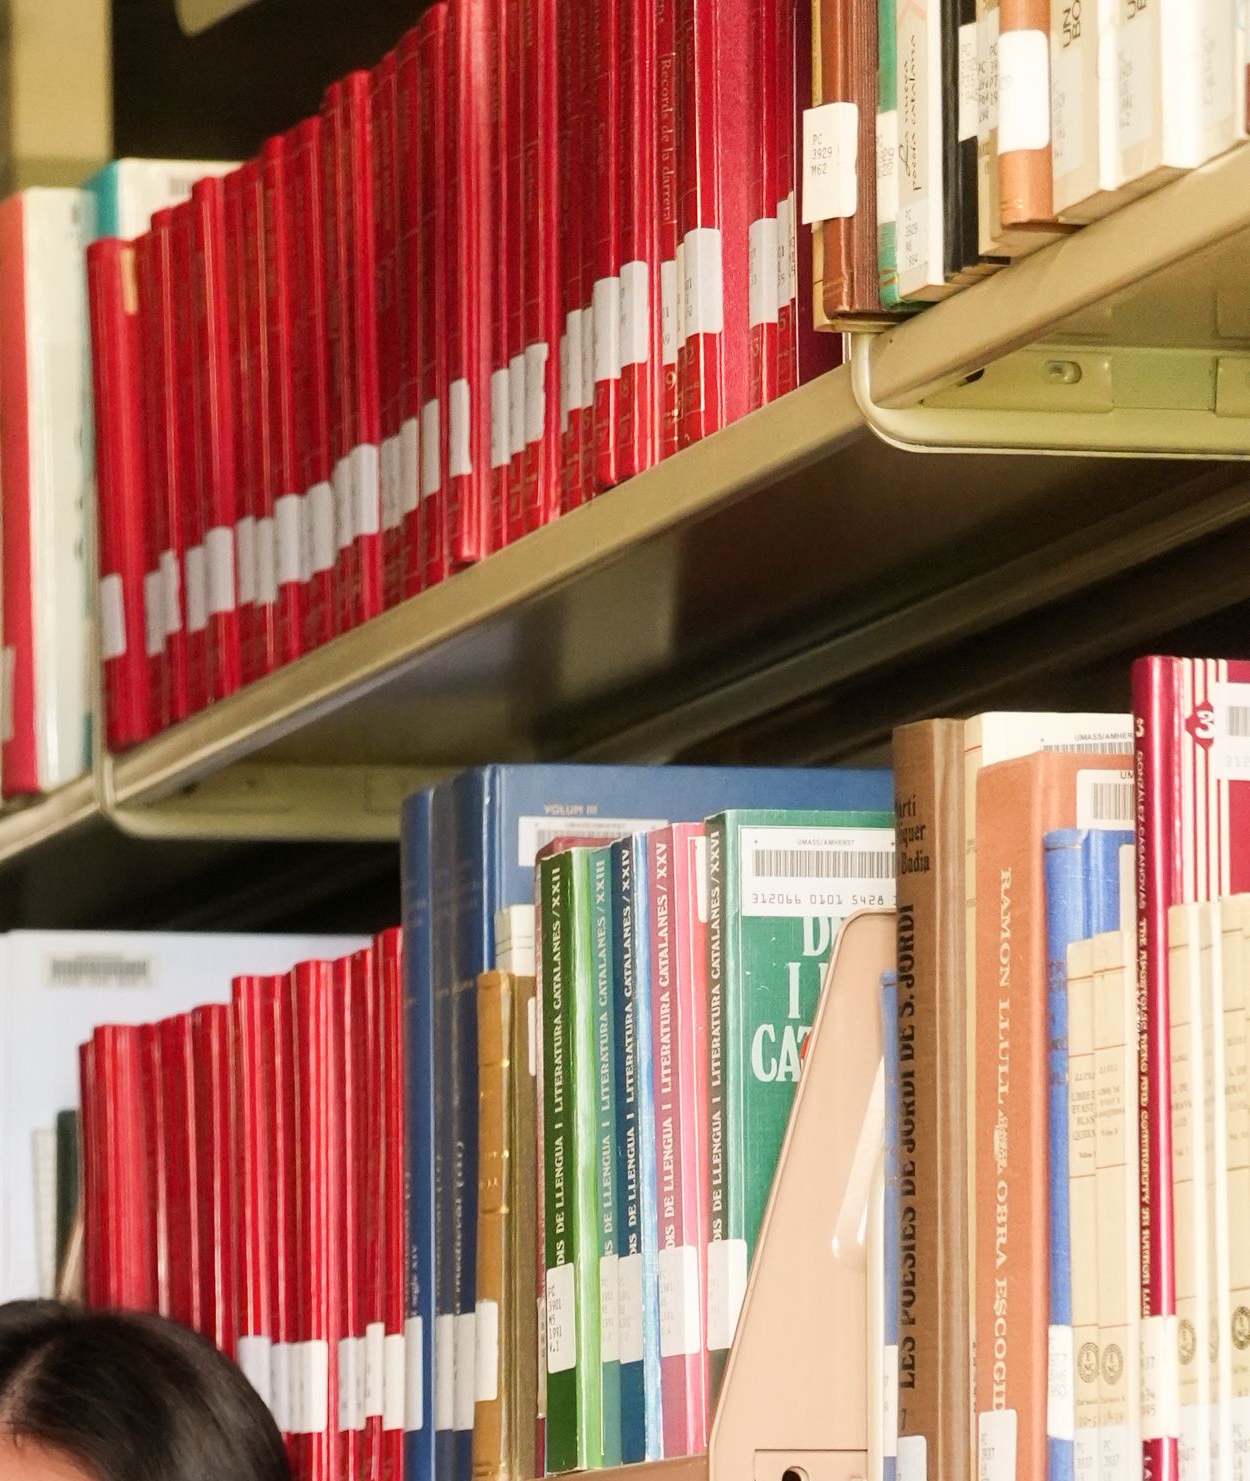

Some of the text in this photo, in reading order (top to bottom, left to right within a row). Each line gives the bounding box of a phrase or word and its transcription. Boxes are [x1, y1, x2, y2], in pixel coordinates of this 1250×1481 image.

[659, 58, 673, 119] Records
[660, 124, 674, 144] de
[811, 164, 828, 176] M62
[812, 134, 823, 145] PC
[812, 148, 833, 160] 3929
[660, 167, 675, 222] darrera
[1074, 732, 1134, 741] UMASS/AMHER
[1196, 710, 1215, 739] 3
[796, 838, 856, 847] UMASS/AMHERST
[710, 886, 721, 979] CATALANES
[751, 893, 884, 906] 312066 0101 5428
[552, 921, 562, 1010] CATALANES
[596, 917, 608, 1006] CATALANES
[622, 906, 633, 998] CATALANES
[656, 894, 670, 986] CATALANES
[553, 1014, 565, 1114] LITERATURA
[599, 1012, 610, 1112] LITERATURA
[624, 1001, 635, 1103] LITERATURA
[658, 991, 672, 1093] LITERATURA
[710, 983, 722, 1087] LITERATURA
[554, 1136, 565, 1214] LLENGUA
[601, 1134, 612, 1210] LLENGUA
[626, 1126, 636, 1204] LLENGUA
[662, 1116, 674, 1189] LLENGUA
[712, 1109, 722, 1183] LLENGUA
[897, 904, 916, 1389] LES POESIES DE JORDI DE S. JORDI
[992, 866, 1012, 1412] RAMON LLULL OBRA ESCOGID
[555, 1217, 565, 1234] DE
[603, 1217, 613, 1234] DE
[628, 1208, 638, 1227] DE
[663, 1191, 675, 1219] DE
[712, 1185, 723, 1212] DE
[548, 1327, 563, 1340] 1991
